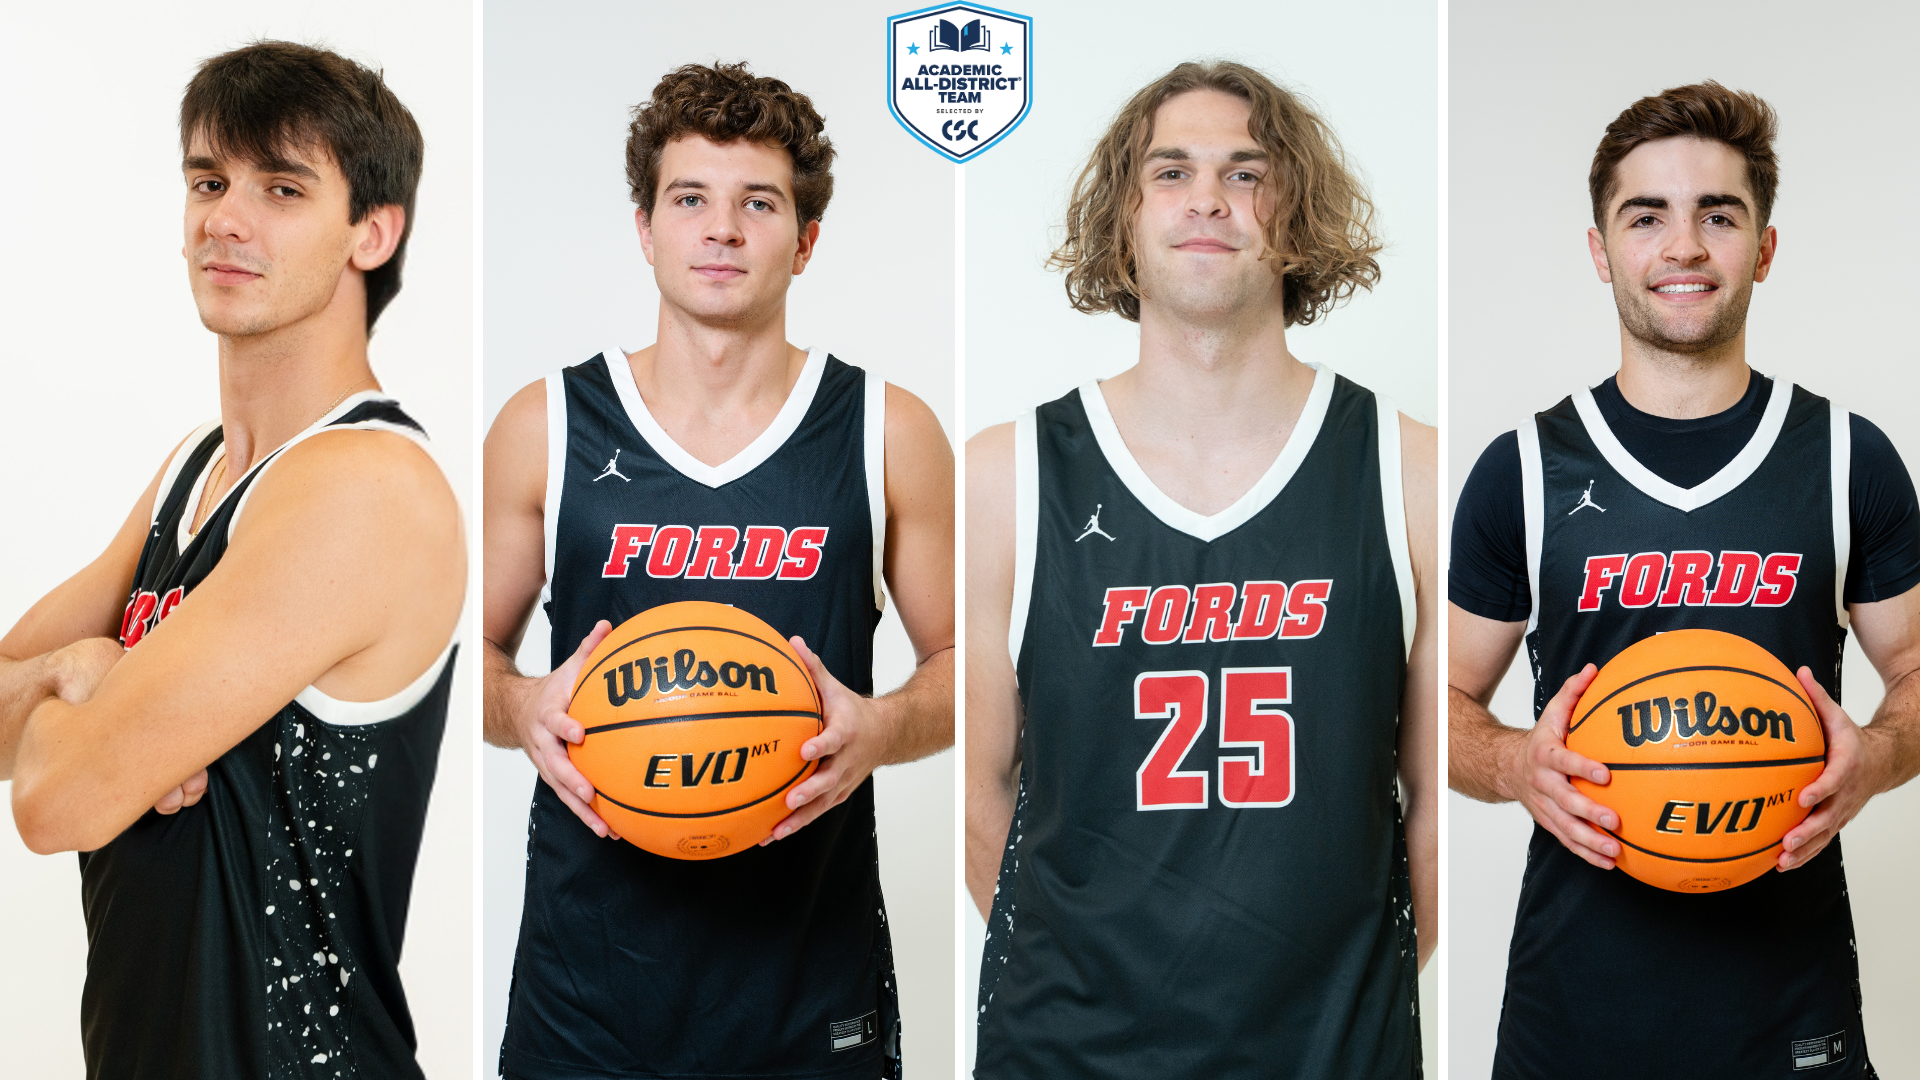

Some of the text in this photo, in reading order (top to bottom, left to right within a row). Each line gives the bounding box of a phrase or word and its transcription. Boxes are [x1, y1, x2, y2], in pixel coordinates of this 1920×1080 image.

[601, 523, 830, 581] FORDS
[1577, 550, 1804, 613] FORDS
[1092, 578, 1334, 647] FORDS
[603, 648, 778, 708] Wilson
[1133, 666, 1296, 811] 25
[1617, 691, 1796, 748] Wilson
[643, 738, 781, 789] EVO NXT
[1655, 787, 1796, 836] EVO NXT
[867, 1021, 873, 1034] L
[1833, 1040, 1842, 1055] M
